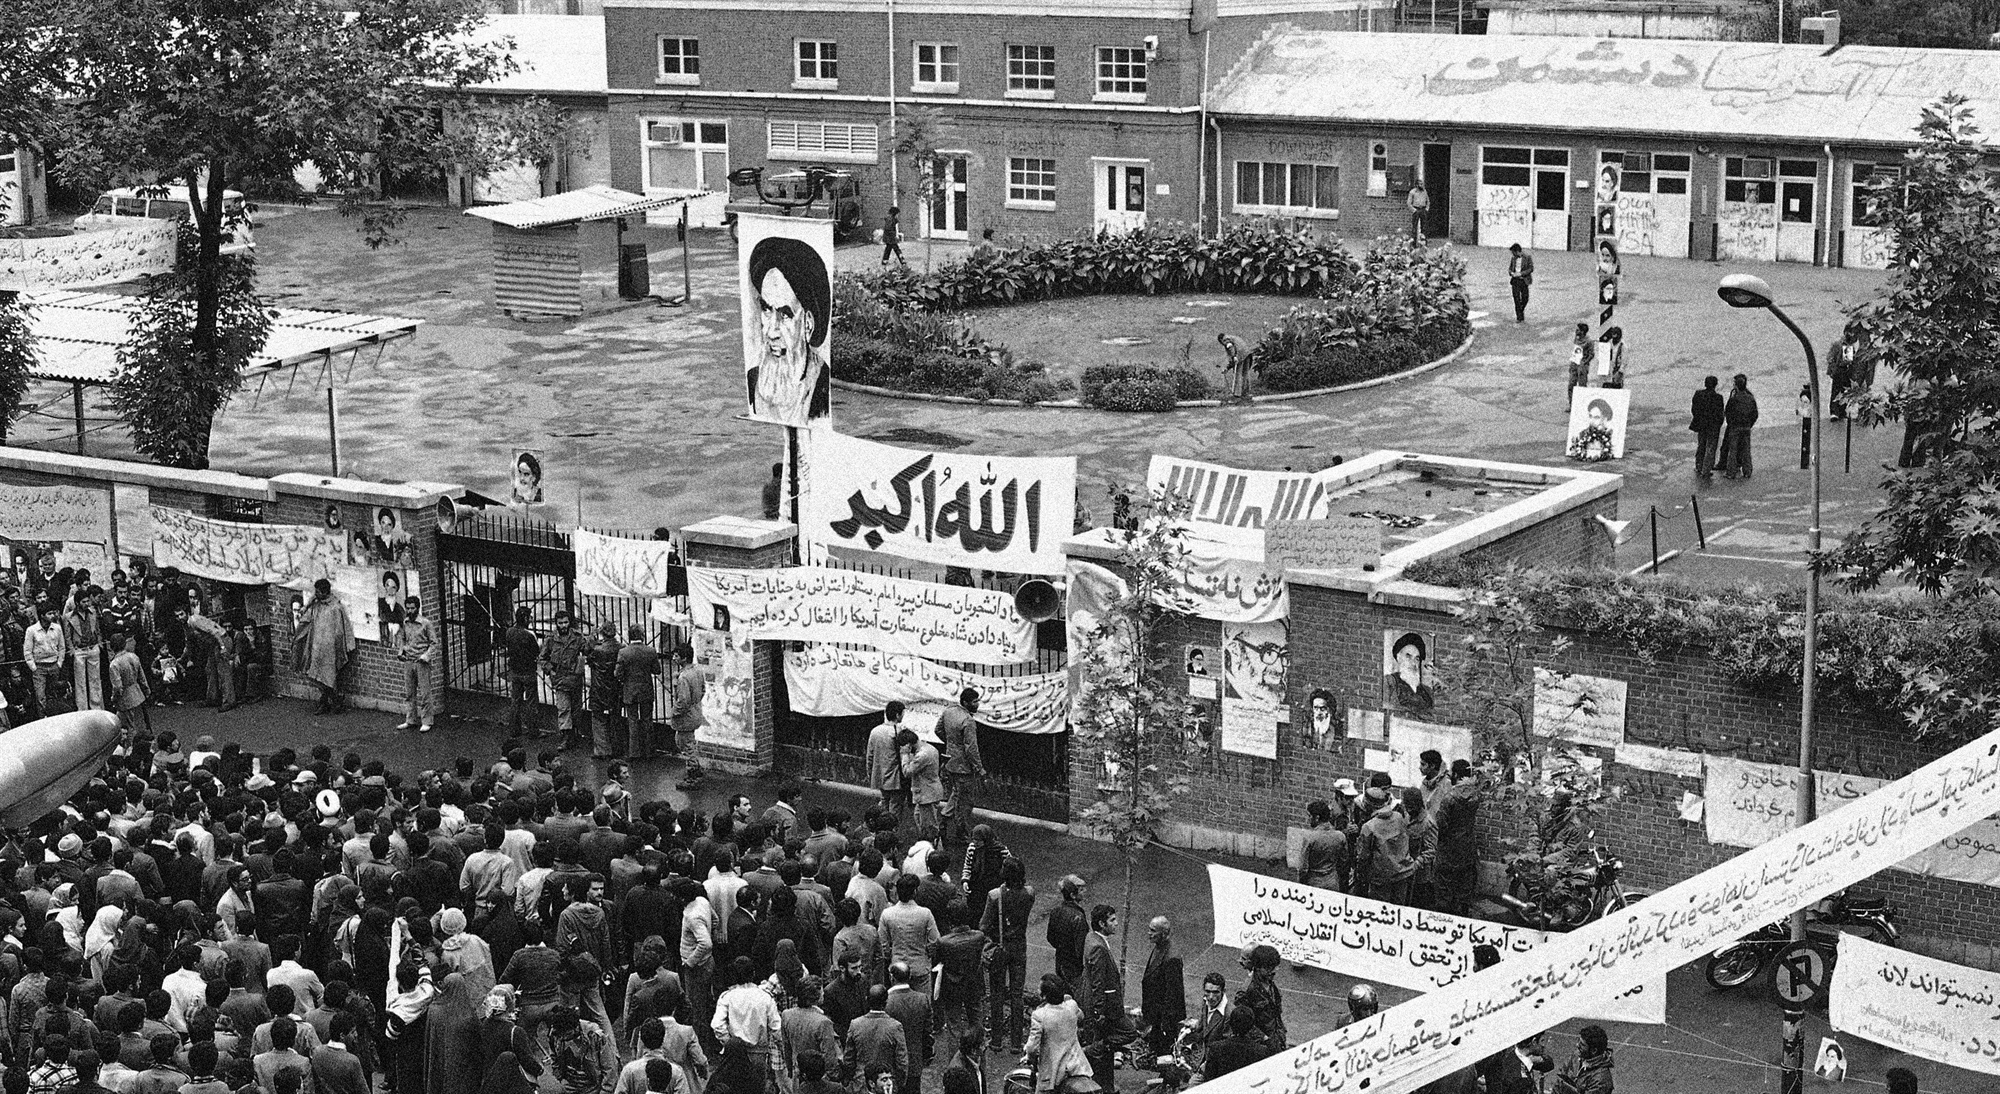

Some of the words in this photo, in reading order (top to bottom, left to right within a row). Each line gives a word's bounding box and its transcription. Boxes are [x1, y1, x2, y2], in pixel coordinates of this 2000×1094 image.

[714, 573, 749, 596] آمریکا
[752, 577, 793, 601] جنایات
[808, 575, 846, 597] اعتراض
[915, 588, 953, 610] مسلمان
[954, 594, 1007, 623] دانشجویان
[771, 602, 803, 627] کرده
[802, 605, 838, 628] اشغال
[840, 606, 849, 627] را
[880, 615, 917, 635] سفارت
[967, 625, 996, 646] دادن
[1254, 877, 1268, 898] را
[1270, 888, 1325, 914] رزمنده
[1243, 908, 1292, 931] اسلامی
[1329, 898, 1413, 931] دانشجویان
[1292, 922, 1339, 943] انقلاب
[1469, 922, 1519, 952] آمریکا
[1340, 931, 1405, 958] اهداف
[1409, 942, 1456, 968] تحقق
[1450, 953, 1469, 975] از
